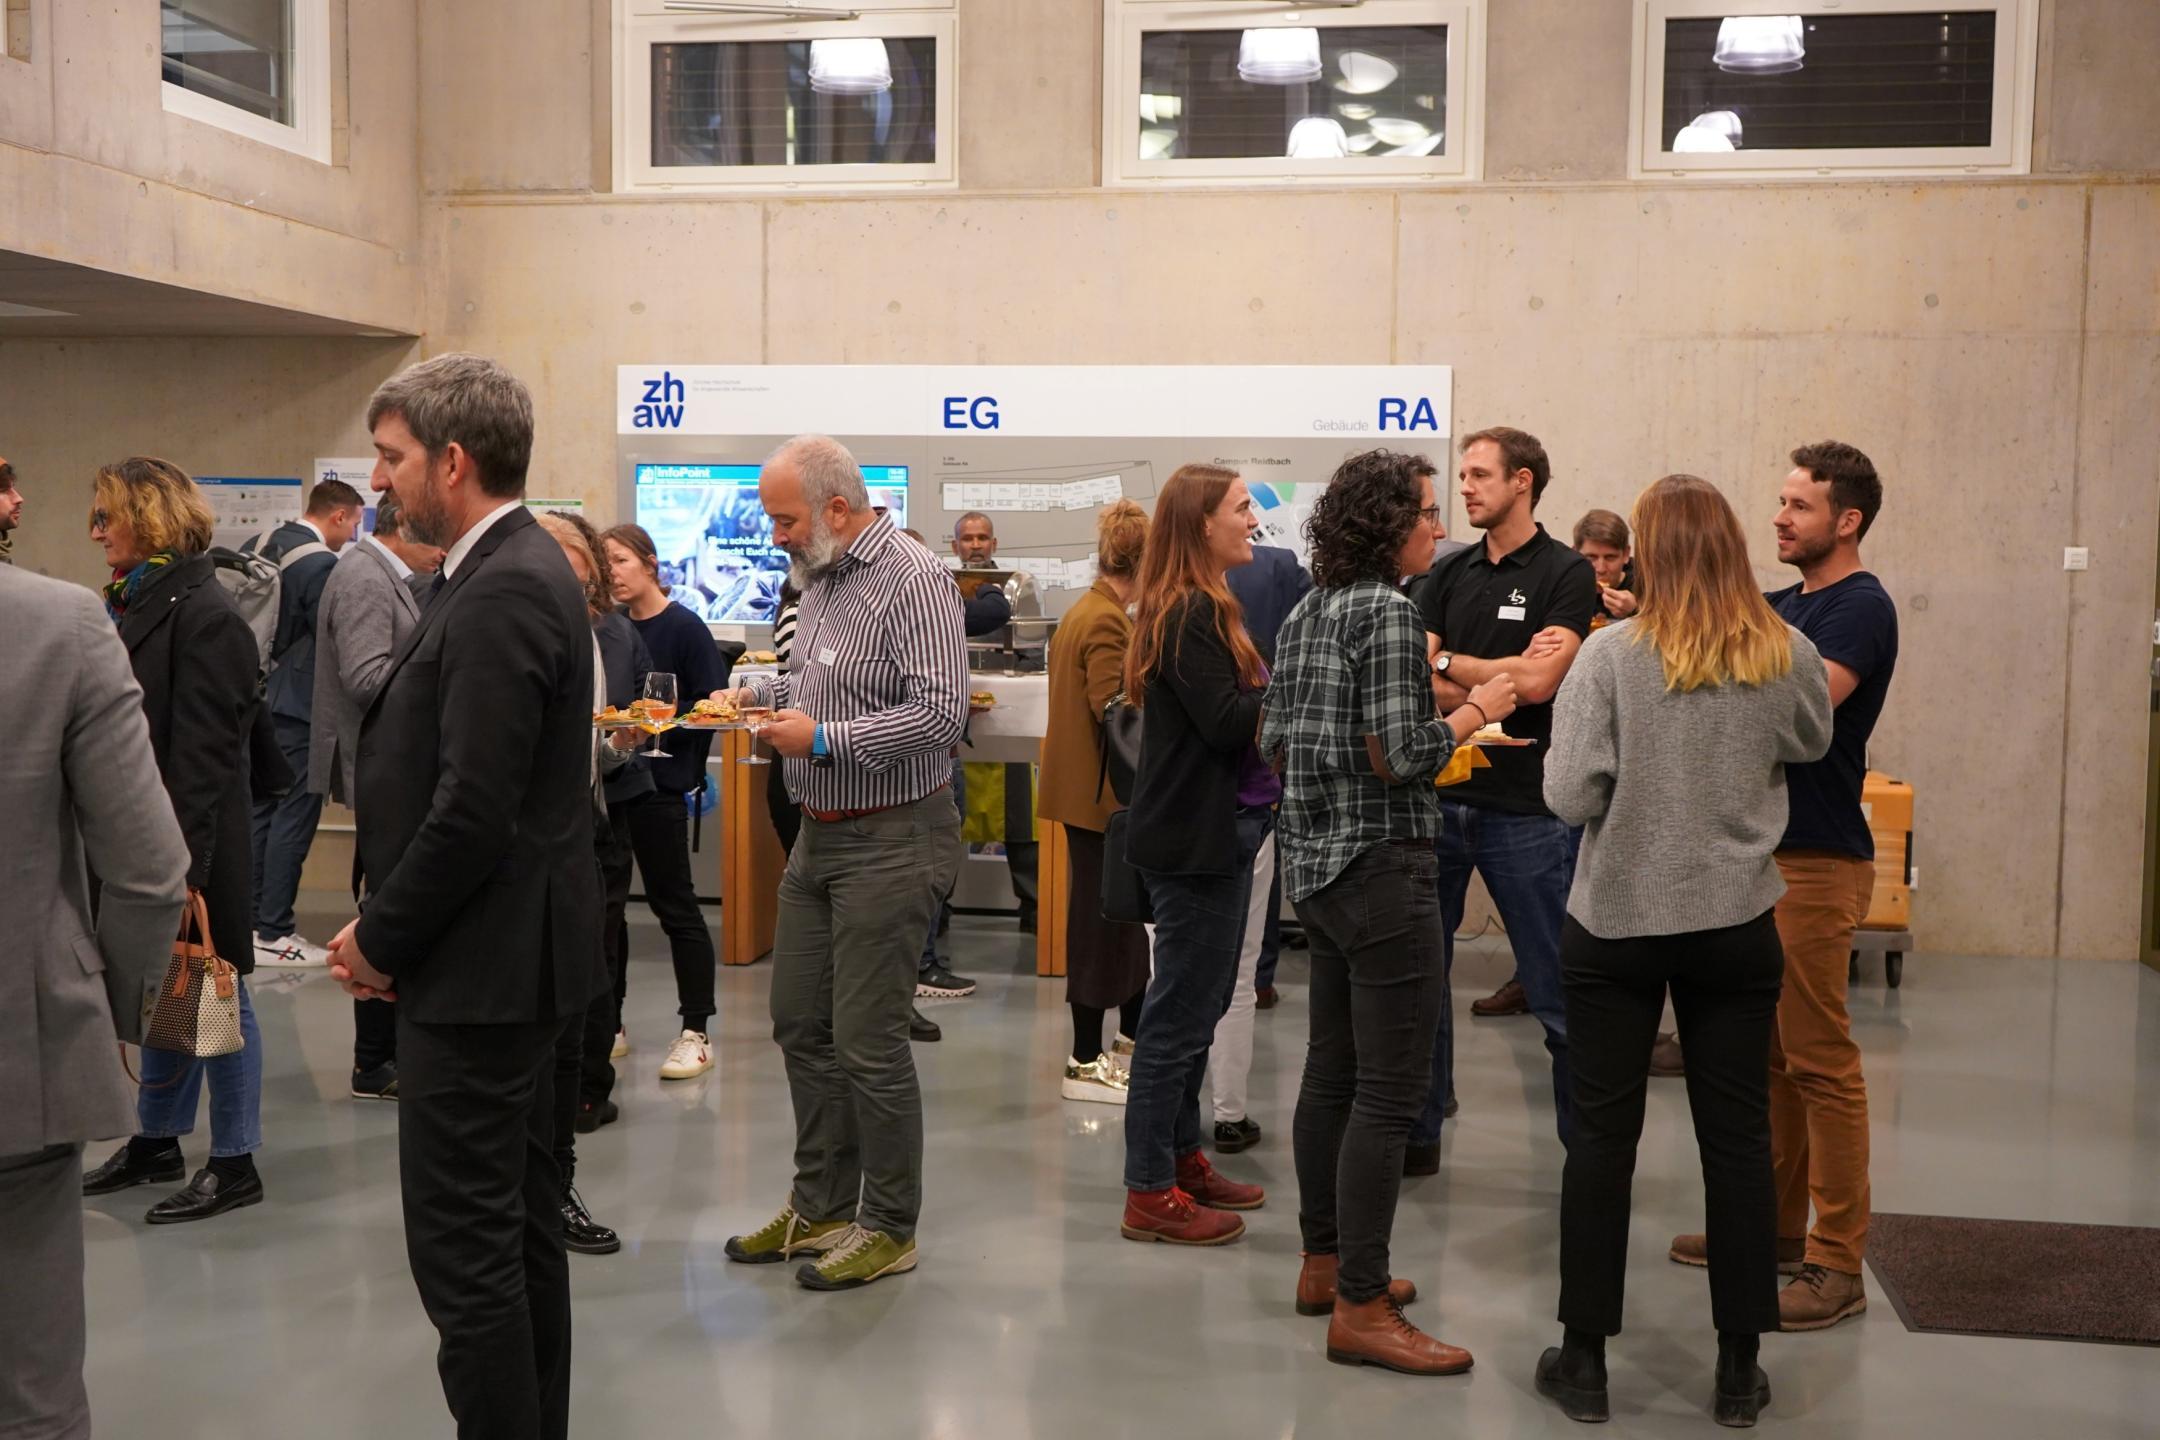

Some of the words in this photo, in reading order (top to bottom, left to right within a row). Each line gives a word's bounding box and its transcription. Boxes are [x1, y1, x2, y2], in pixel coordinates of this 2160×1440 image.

[642, 371, 684, 402] zh
[632, 404, 684, 428] aw
[943, 396, 999, 430] EG
[1313, 419, 1369, 432] Gebäude
[1378, 397, 1438, 431] RA
[1214, 457, 1249, 466] Campus
[1251, 457, 1291, 466] Reidbach
[657, 466, 711, 478] InfoPoint
[730, 536, 761, 545] schöne
[746, 548, 768, 556] Euch
